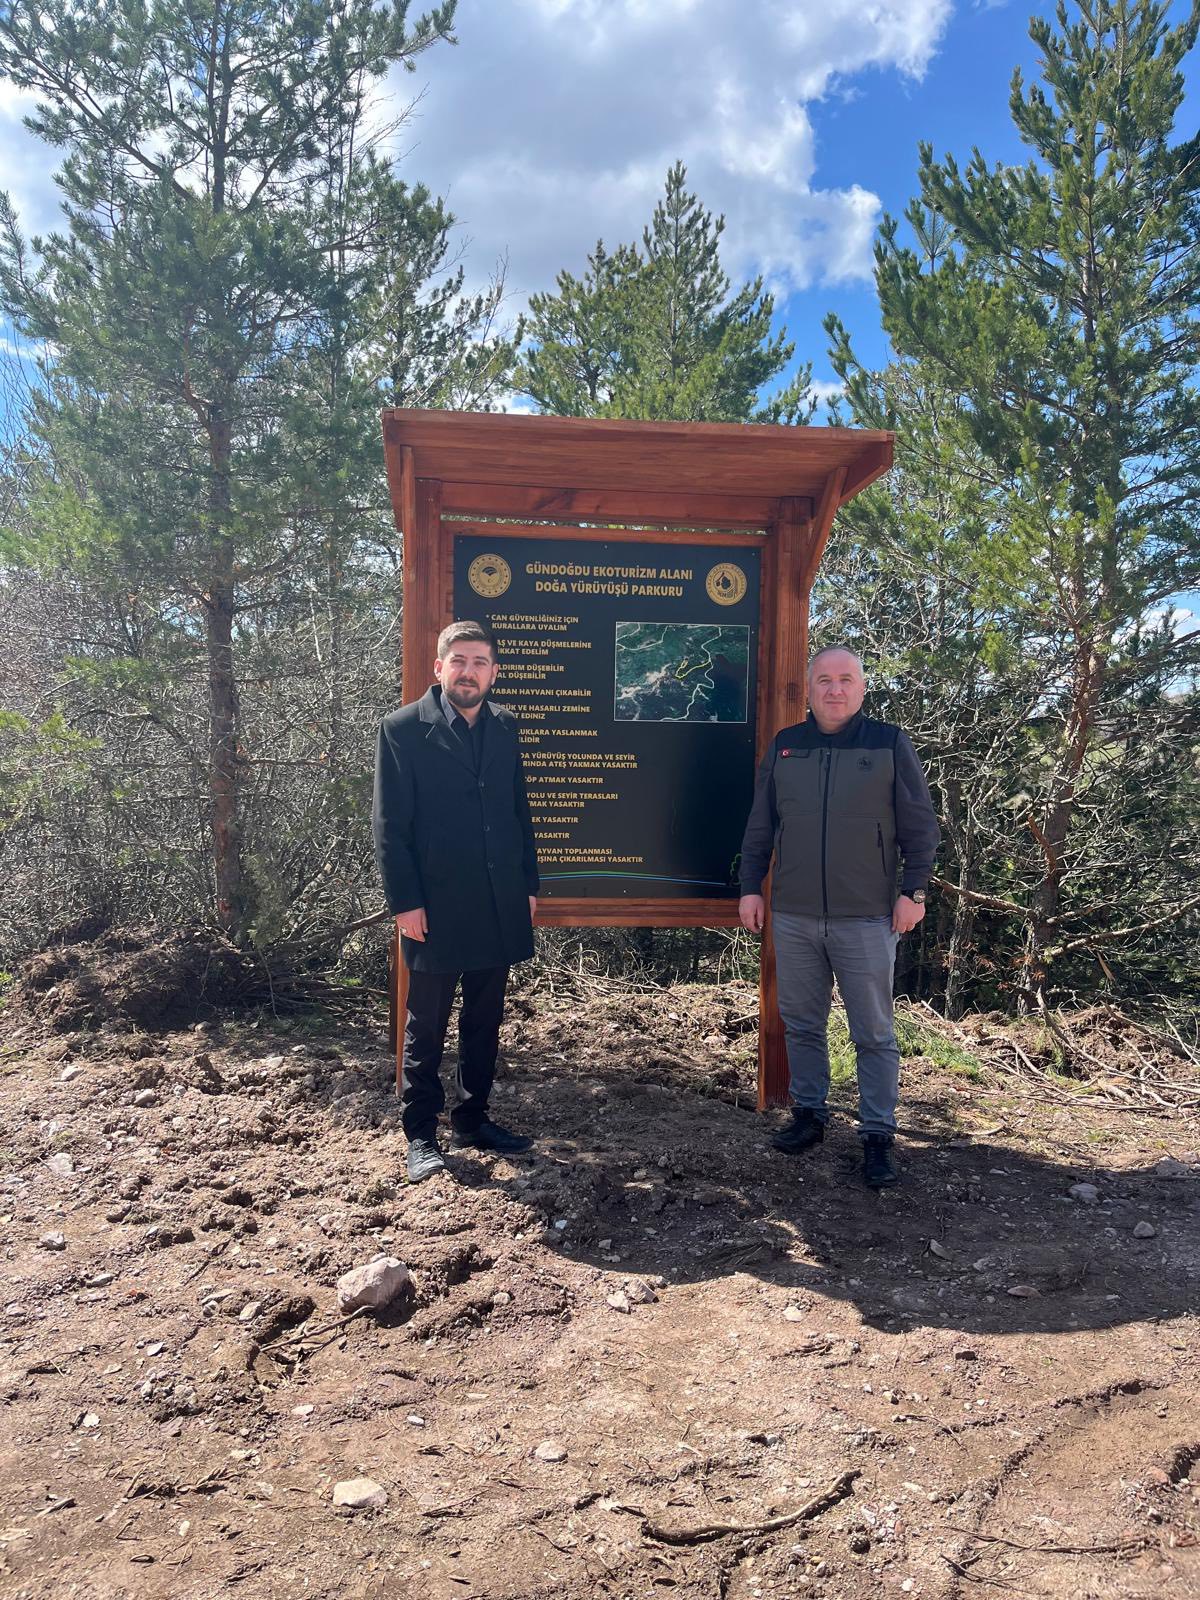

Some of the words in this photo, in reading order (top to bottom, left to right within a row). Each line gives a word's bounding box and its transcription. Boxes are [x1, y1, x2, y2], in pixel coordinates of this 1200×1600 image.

[526, 561, 590, 577] GÜNDOĞDU
[593, 565, 656, 579] EKOTURİZM
[659, 568, 693, 580] ALANI
[535, 579, 567, 593] DOĞA
[570, 581, 628, 597] YÜRÜYÜŞÜ
[631, 584, 683, 597] PARKURU
[509, 614, 562, 623] GÜVENLİĞİNİZ
[541, 640, 592, 649] DÜŞMELERİNE
[526, 664, 565, 672] DÜŞEBİLİR
[508, 671, 546, 680] DÜŞEBİLİR
[556, 689, 592, 698] ÇIKABİLİR
[532, 752, 566, 760] YÜRÜYÜŞ
